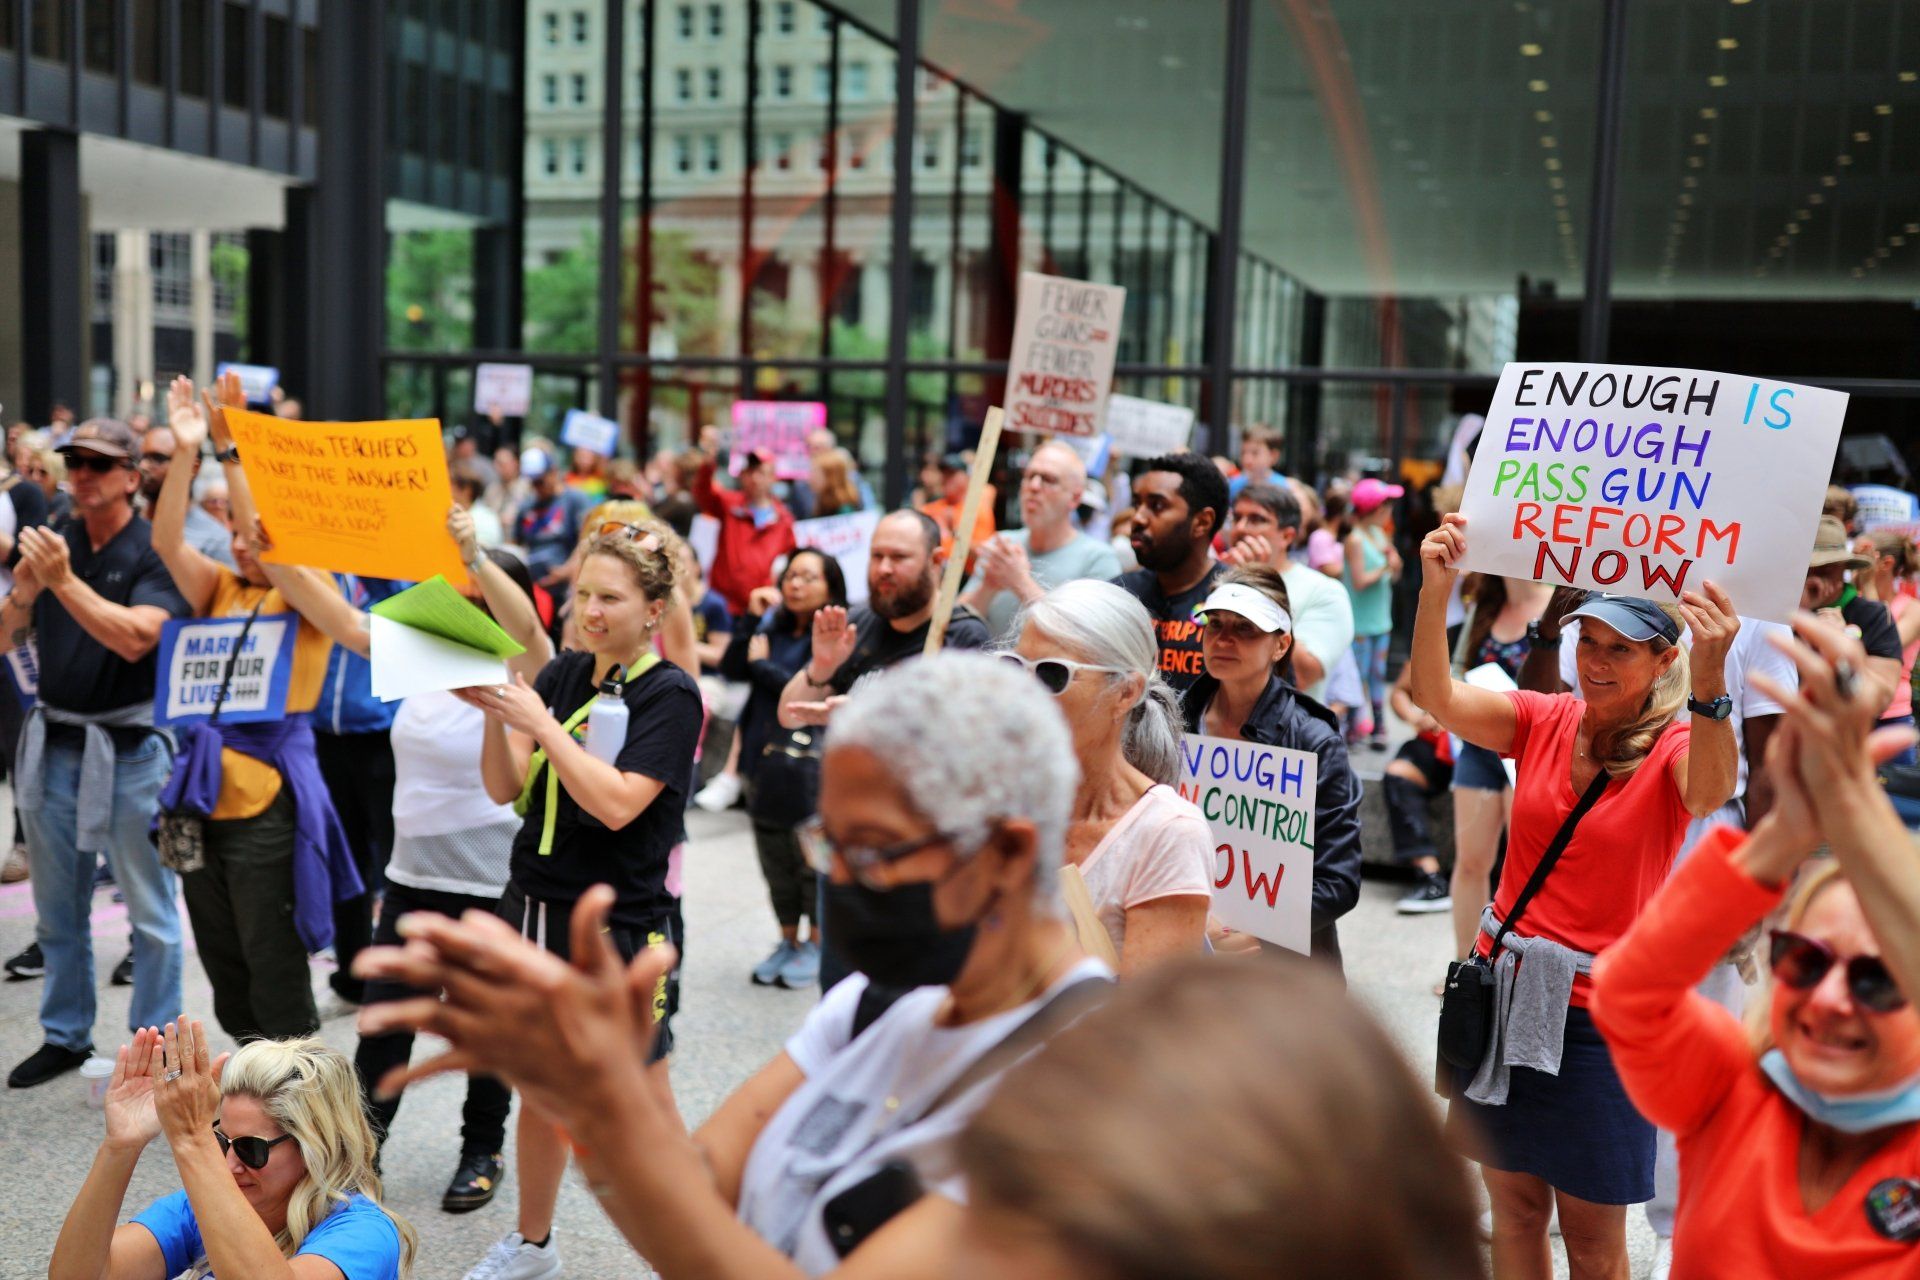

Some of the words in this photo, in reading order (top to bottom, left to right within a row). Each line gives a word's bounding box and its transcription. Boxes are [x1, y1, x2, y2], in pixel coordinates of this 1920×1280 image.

[1040, 281, 1109, 320] FEWER
[1026, 341, 1095, 376] FEWER
[1514, 369, 1720, 416] ENOUGH
[1743, 382, 1794, 430] IS
[326, 434, 418, 458] TEACHERS
[1505, 417, 1711, 467] ENOUGH
[304, 464, 338, 486] THE
[1492, 459, 1590, 503] PASS
[1601, 467, 1712, 510] GUN
[1512, 502, 1741, 565] REFORM
[1533, 541, 1693, 598] NOW
[182, 661, 219, 681] FOR
[227, 658, 264, 677] UR
[185, 635, 257, 656] MARH
[1180, 739, 1304, 798] NOUGH
[1203, 786, 1315, 850] CONTROL
[1214, 843, 1285, 909] OW
